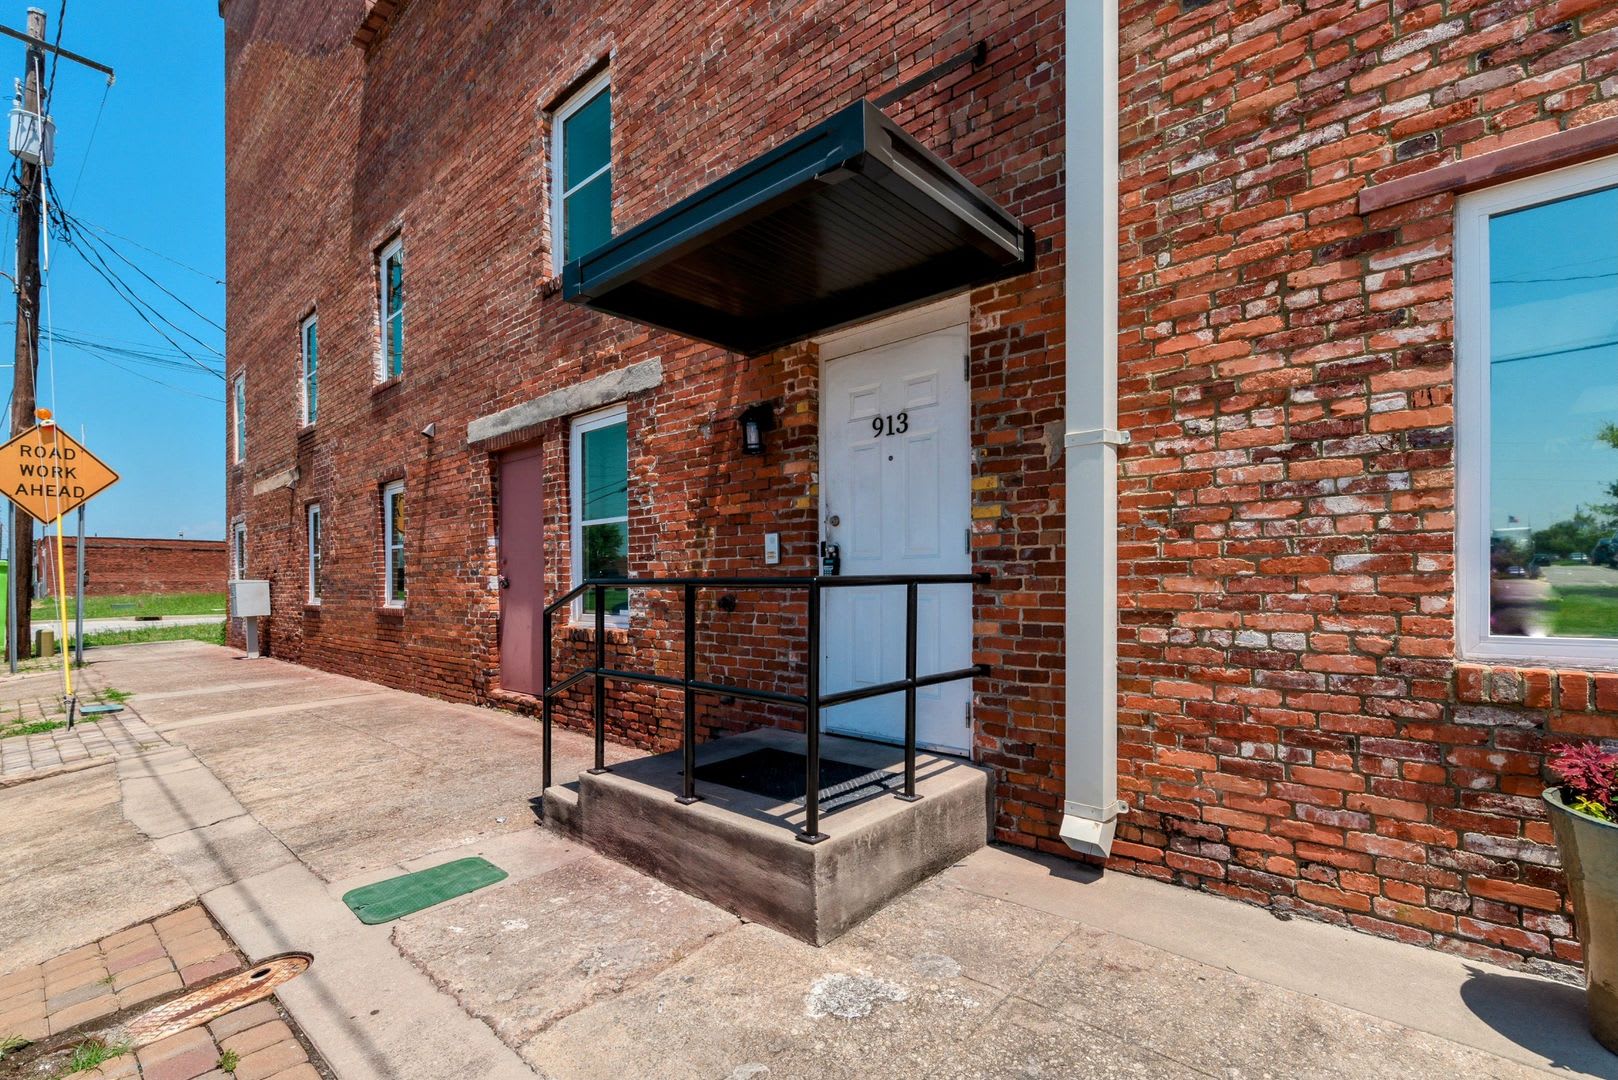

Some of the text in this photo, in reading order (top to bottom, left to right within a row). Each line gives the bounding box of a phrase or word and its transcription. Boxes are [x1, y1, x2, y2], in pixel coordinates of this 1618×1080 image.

[872, 413, 908, 438] 913
[20, 445, 76, 460] ROAD
[20, 464, 77, 479] WORK
[15, 483, 85, 498] AHEAD
